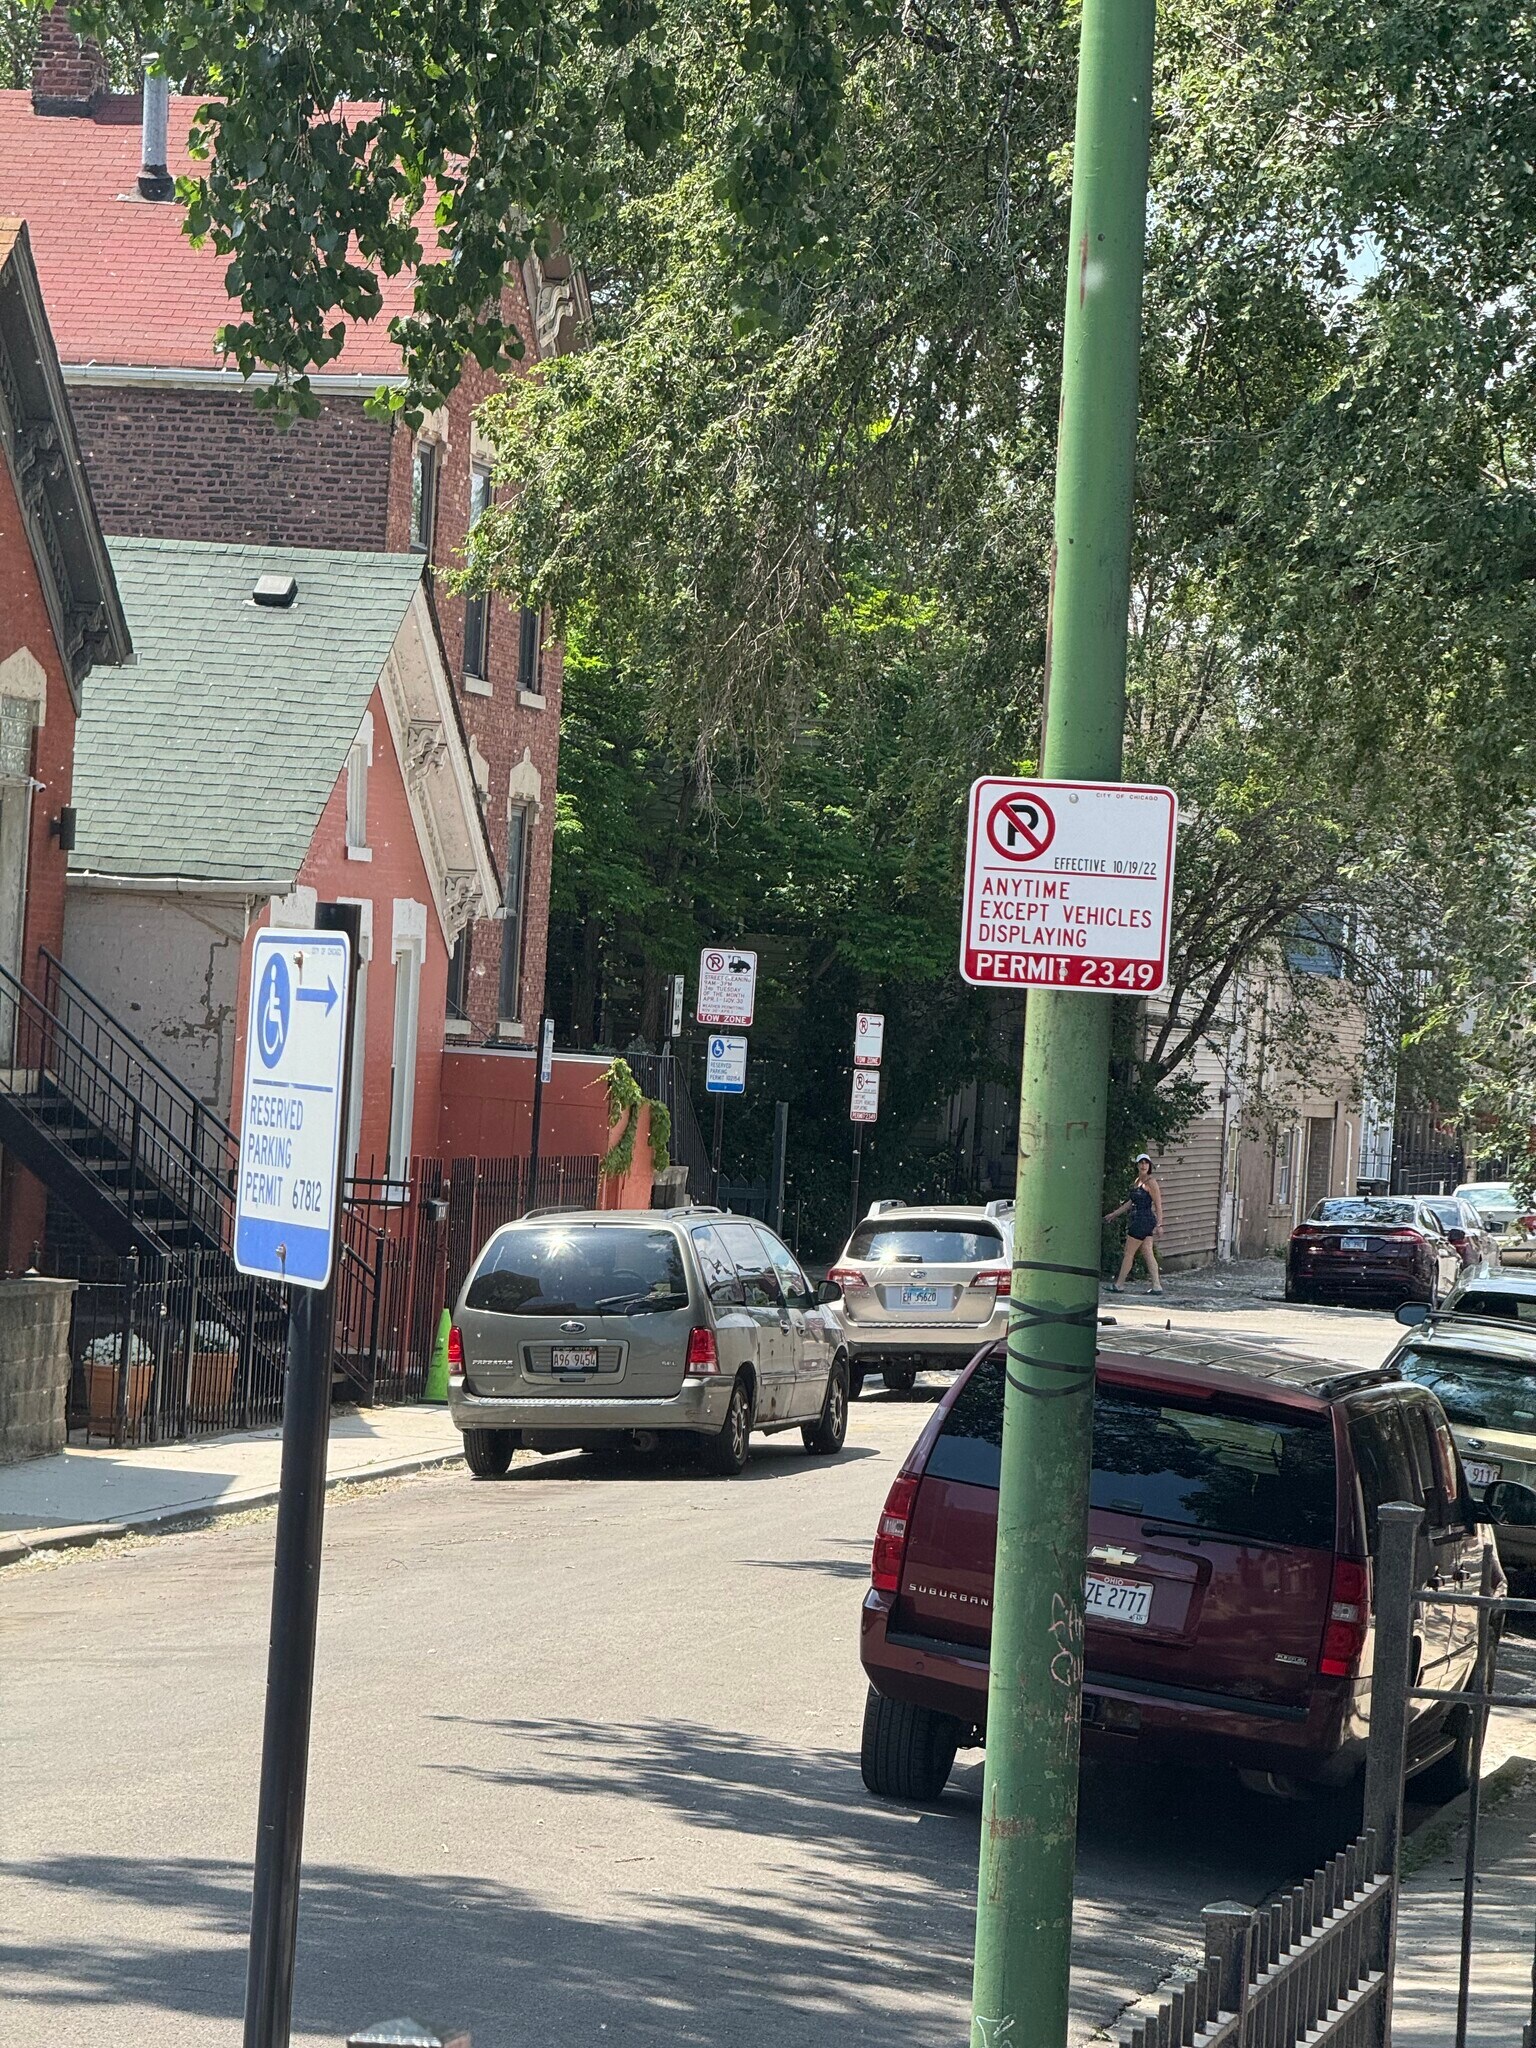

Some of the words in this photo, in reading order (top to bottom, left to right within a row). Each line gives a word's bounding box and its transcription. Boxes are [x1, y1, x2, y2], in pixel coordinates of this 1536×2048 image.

[1054, 857, 1106, 873] EFFECTIVE
[1113, 860, 1157, 875] 10/19/22
[981, 877, 1070, 900] ANYTIME
[979, 900, 1049, 922] EXCEPT
[1063, 905, 1152, 928] VEHICLES
[978, 923, 1087, 948] DISPLAYING
[975, 952, 1070, 982] PERMIT
[1079, 959, 1154, 988] 2349
[701, 1014, 720, 1022] TOW
[723, 1016, 747, 1024] ZONE
[249, 1094, 304, 1131] RESERVED
[247, 1133, 292, 1169] PARKING
[245, 1171, 284, 1207] PERMIT
[292, 1179, 322, 1212] 67812
[553, 1353, 570, 1366] A96
[574, 1353, 596, 1366] 9454
[1104, 1576, 1124, 1586] OHIO
[908, 1583, 989, 1606] SUBURBAN
[1086, 1582, 1105, 1606] ZE
[1107, 1588, 1147, 1613] 2777
